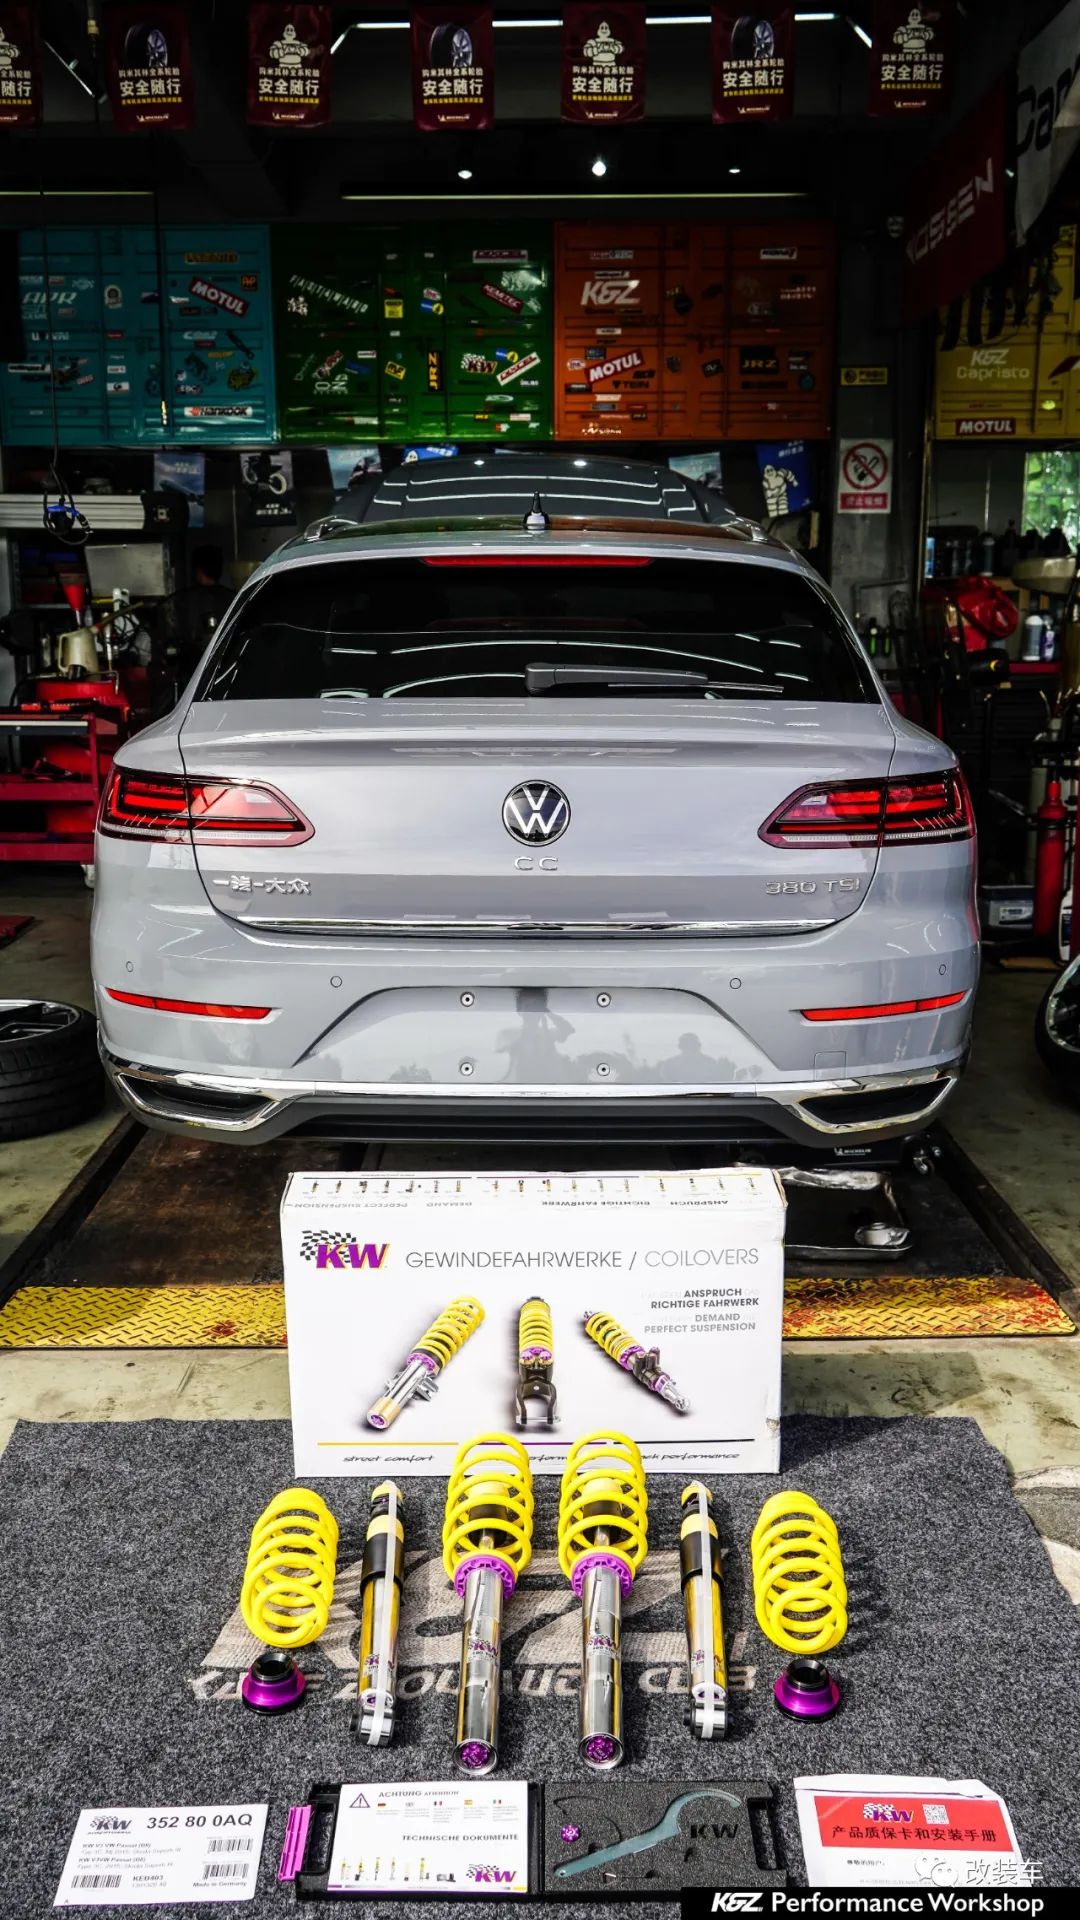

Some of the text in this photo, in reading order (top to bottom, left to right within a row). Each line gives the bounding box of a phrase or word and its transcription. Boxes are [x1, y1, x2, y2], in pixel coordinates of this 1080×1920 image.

[722, 70, 784, 89] 安全随行
[881, 64, 943, 81] 安全随行
[1, 81, 32, 97] 随行
[119, 78, 182, 97] 安全随行
[258, 78, 319, 96] 安全随行
[422, 78, 484, 96] 安全随行
[572, 77, 633, 94] 安全随行
[22, 292, 78, 304] APR
[191, 281, 245, 315] MOTUL
[580, 279, 641, 306] K&Z
[971, 348, 1010, 366] K&Z
[468, 360, 498, 375] KW
[590, 352, 641, 382] MOTUL
[957, 367, 1030, 382] Capristo
[959, 420, 1014, 433] MOTUL
[514, 856, 558, 871] CC
[766, 878, 860, 894] 380 TSI
[316, 1243, 390, 1269] KW
[406, 1251, 622, 1268] GEWINDEFAHRWERKE
[645, 1248, 759, 1267] COILOVERS
[684, 1288, 742, 1298] ANSPRUCH
[651, 1298, 759, 1309] RICHTIGE FAHRWERK
[695, 1313, 740, 1322] DEMAND
[644, 1322, 756, 1333] PERFECT SUSPENSION
[384, 1454, 433, 1463] comfort
[661, 1452, 740, 1462] performance
[638, 1666, 757, 1696] CLB
[378, 1790, 422, 1798] ACHTUNG
[147, 1814, 253, 1829] 352 80 0AQ
[872, 1808, 914, 1823] KW
[96, 1819, 132, 1830] KW
[690, 1824, 739, 1839] KW
[831, 1825, 997, 1843] 产品质保卡和安装手册
[474, 1870, 517, 1883] KW
